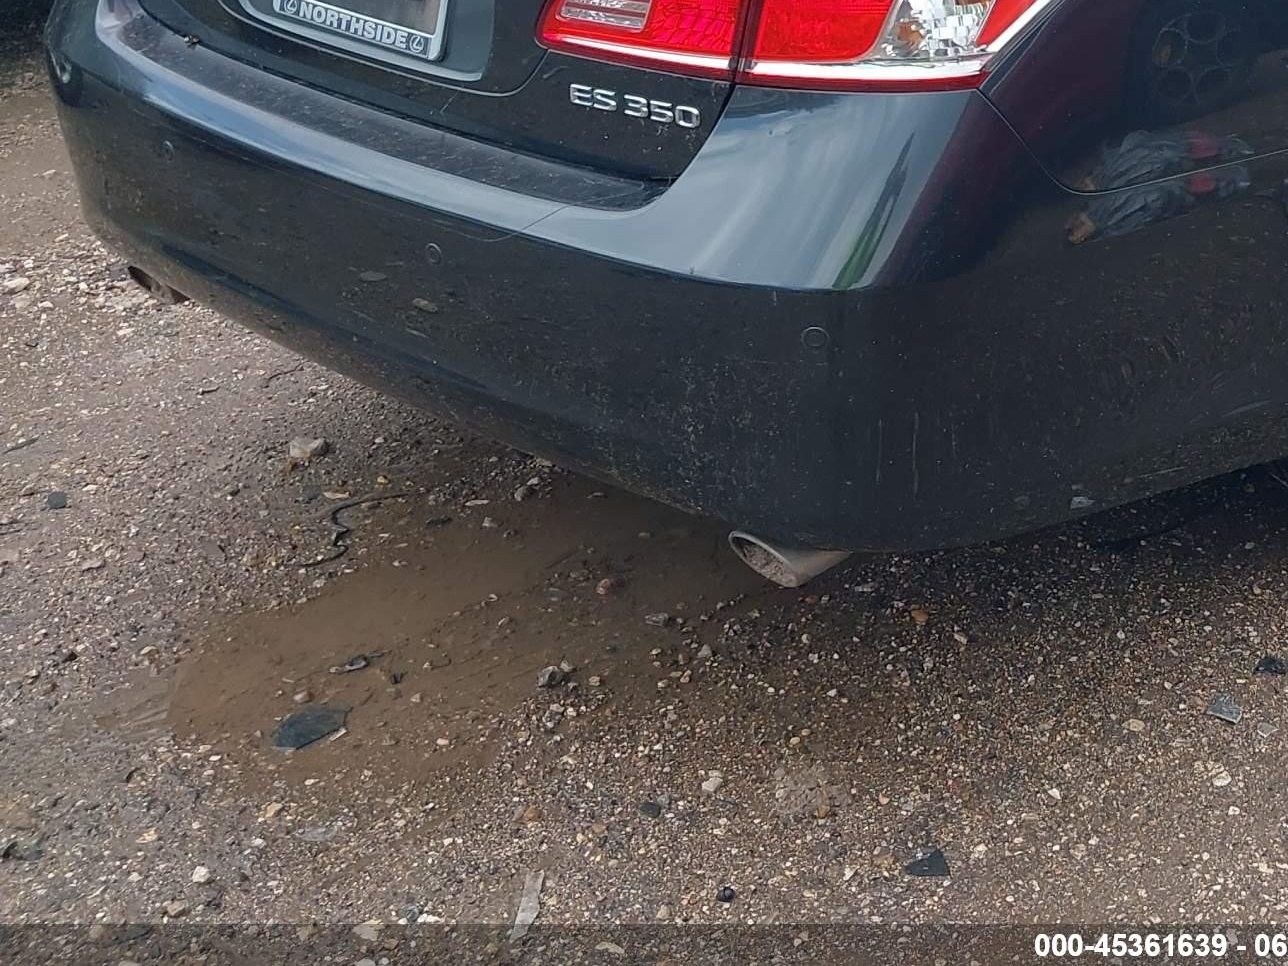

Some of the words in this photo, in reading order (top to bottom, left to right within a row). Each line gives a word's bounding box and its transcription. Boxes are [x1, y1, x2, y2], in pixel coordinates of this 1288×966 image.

[299, 1, 408, 49] NORTHSIDE
[570, 83, 617, 111] ES
[623, 94, 701, 129] 350
